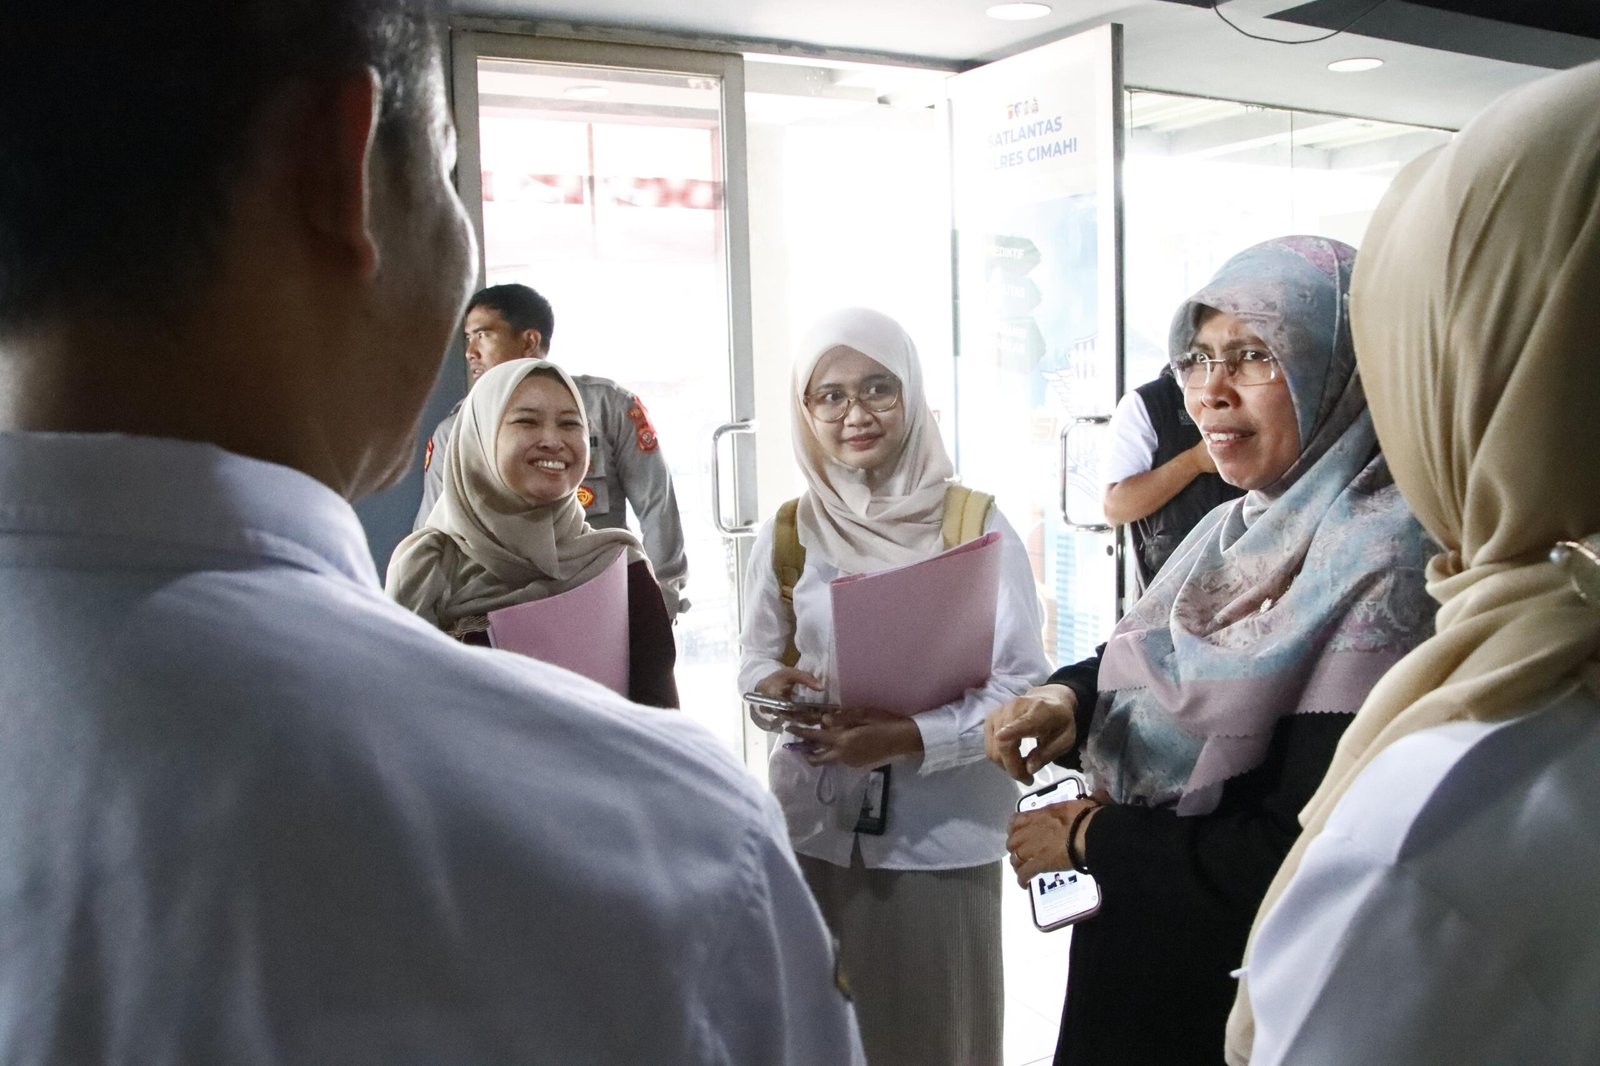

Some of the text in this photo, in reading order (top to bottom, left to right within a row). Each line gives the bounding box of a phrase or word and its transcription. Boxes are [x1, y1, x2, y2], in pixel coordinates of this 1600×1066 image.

[987, 116, 1062, 148] SATLANTAS
[993, 137, 1077, 170] LRES CIMAHI
